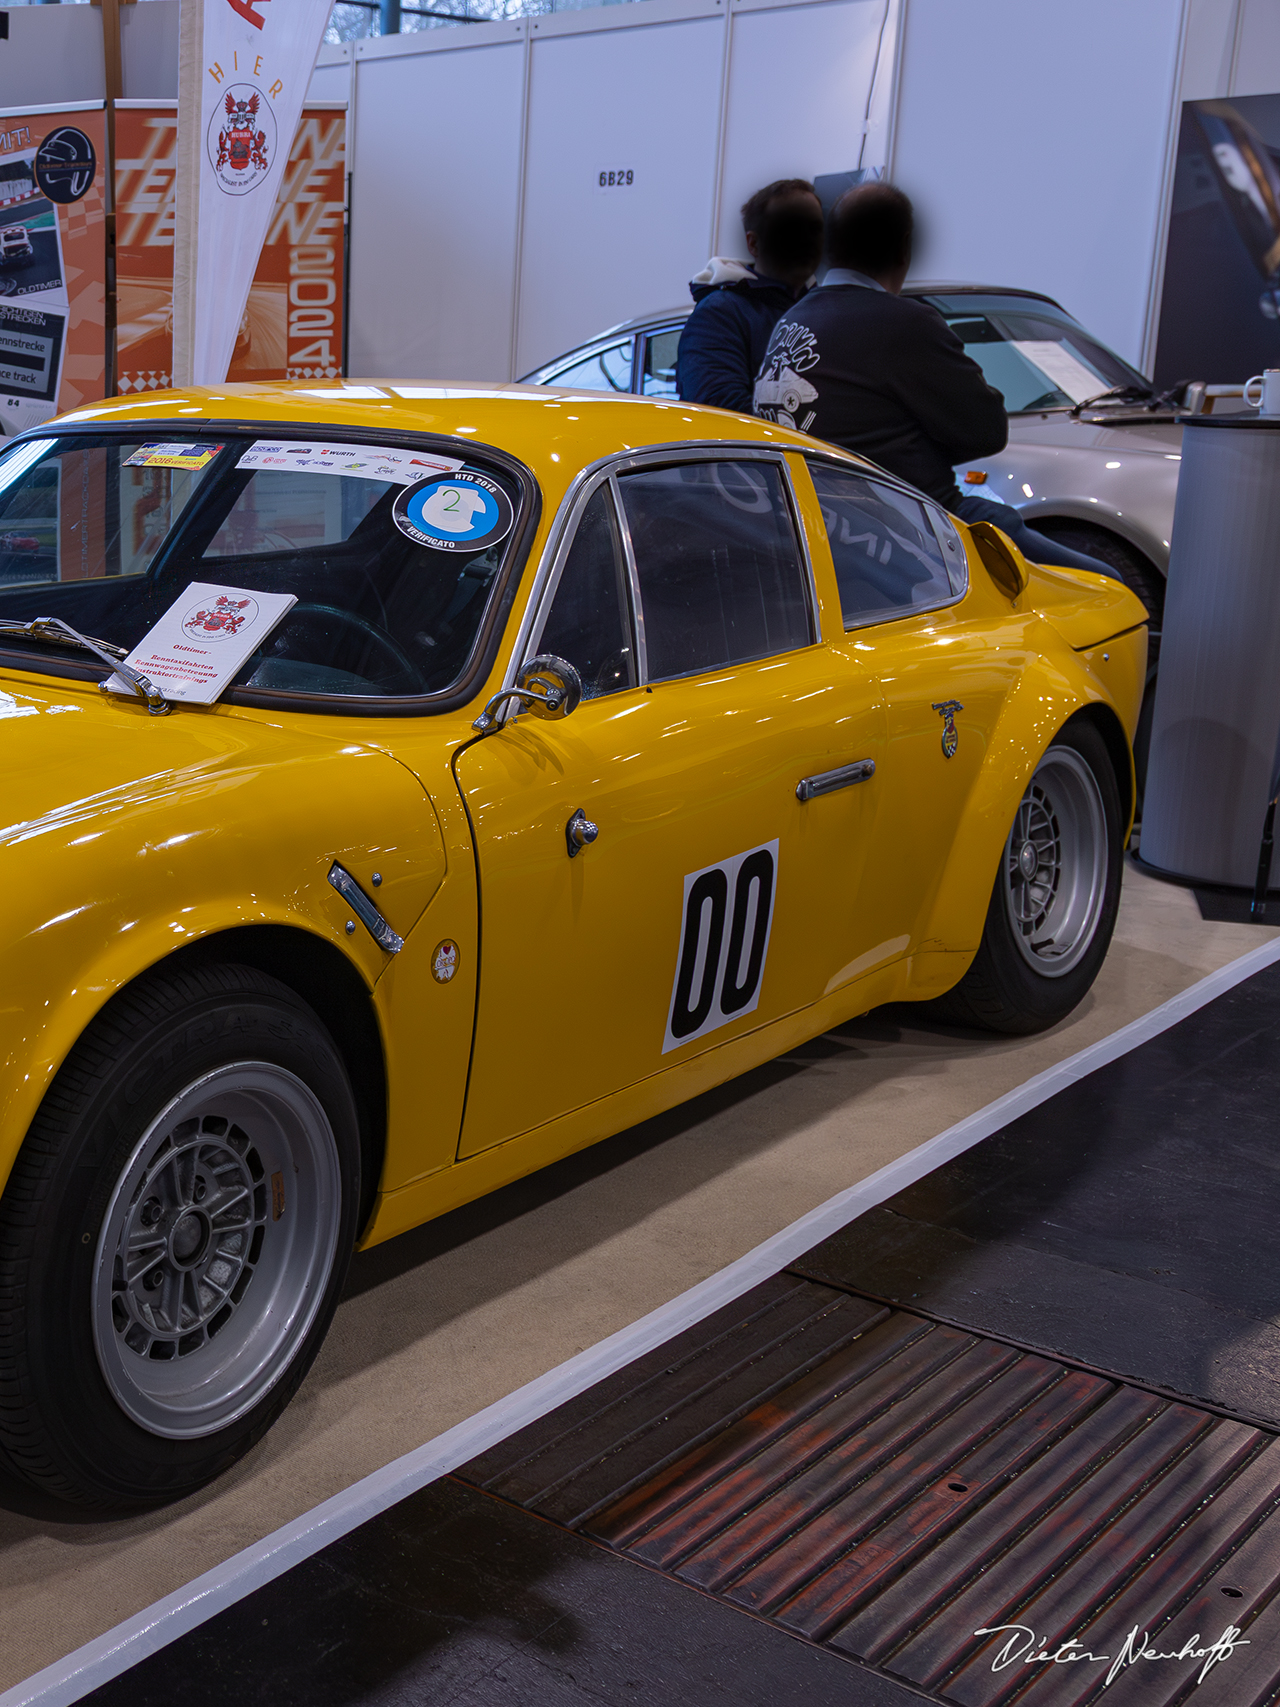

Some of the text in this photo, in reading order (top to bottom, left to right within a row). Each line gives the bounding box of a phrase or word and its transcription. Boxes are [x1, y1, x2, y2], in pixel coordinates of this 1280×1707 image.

[208, 50, 283, 100] HIER
[599, 170, 634, 187] 6B29
[17, 280, 62, 294] OLDTIMER
[288, 246, 337, 367] 2024
[13, 371, 36, 384] track
[455, 473, 497, 493] HTD 2018
[442, 489, 461, 513] 2
[406, 526, 455, 549] VERIFICATO
[173, 644, 212, 656] Oldtimer-
[134, 659, 218, 678] Rennwagenbetreuung
[151, 654, 214, 670] Renntaxifahrten
[671, 848, 774, 1039] 00
